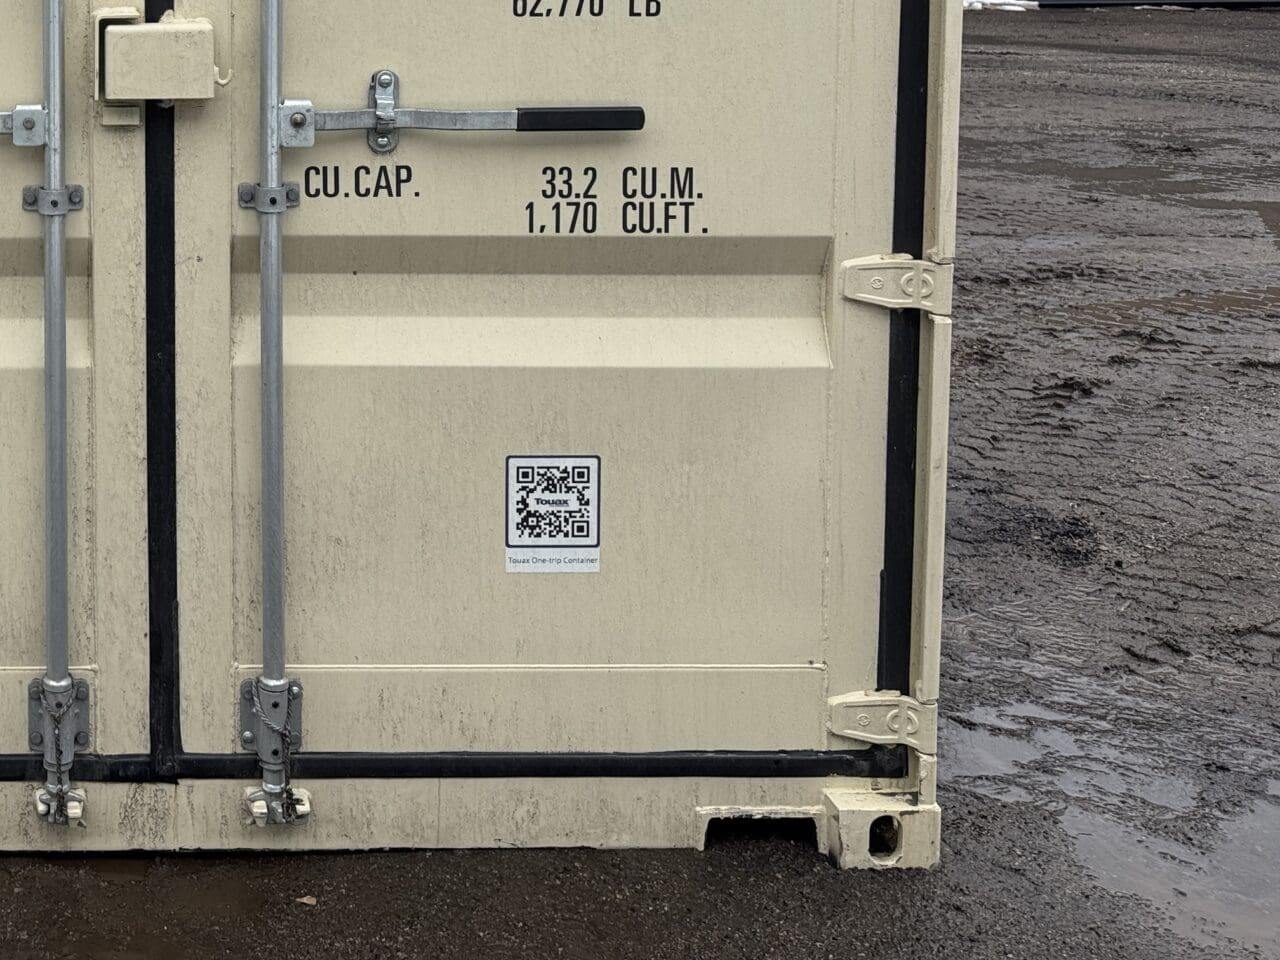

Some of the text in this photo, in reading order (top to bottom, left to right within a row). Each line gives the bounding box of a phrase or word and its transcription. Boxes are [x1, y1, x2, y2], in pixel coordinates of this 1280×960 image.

[305, 166, 704, 200] CU.CAP. 33.2 CU.M.
[526, 202, 709, 235] 1,170 CU.FT.
[534, 497, 569, 506] Touax
[508, 556, 598, 566] Touax One-trip Container
